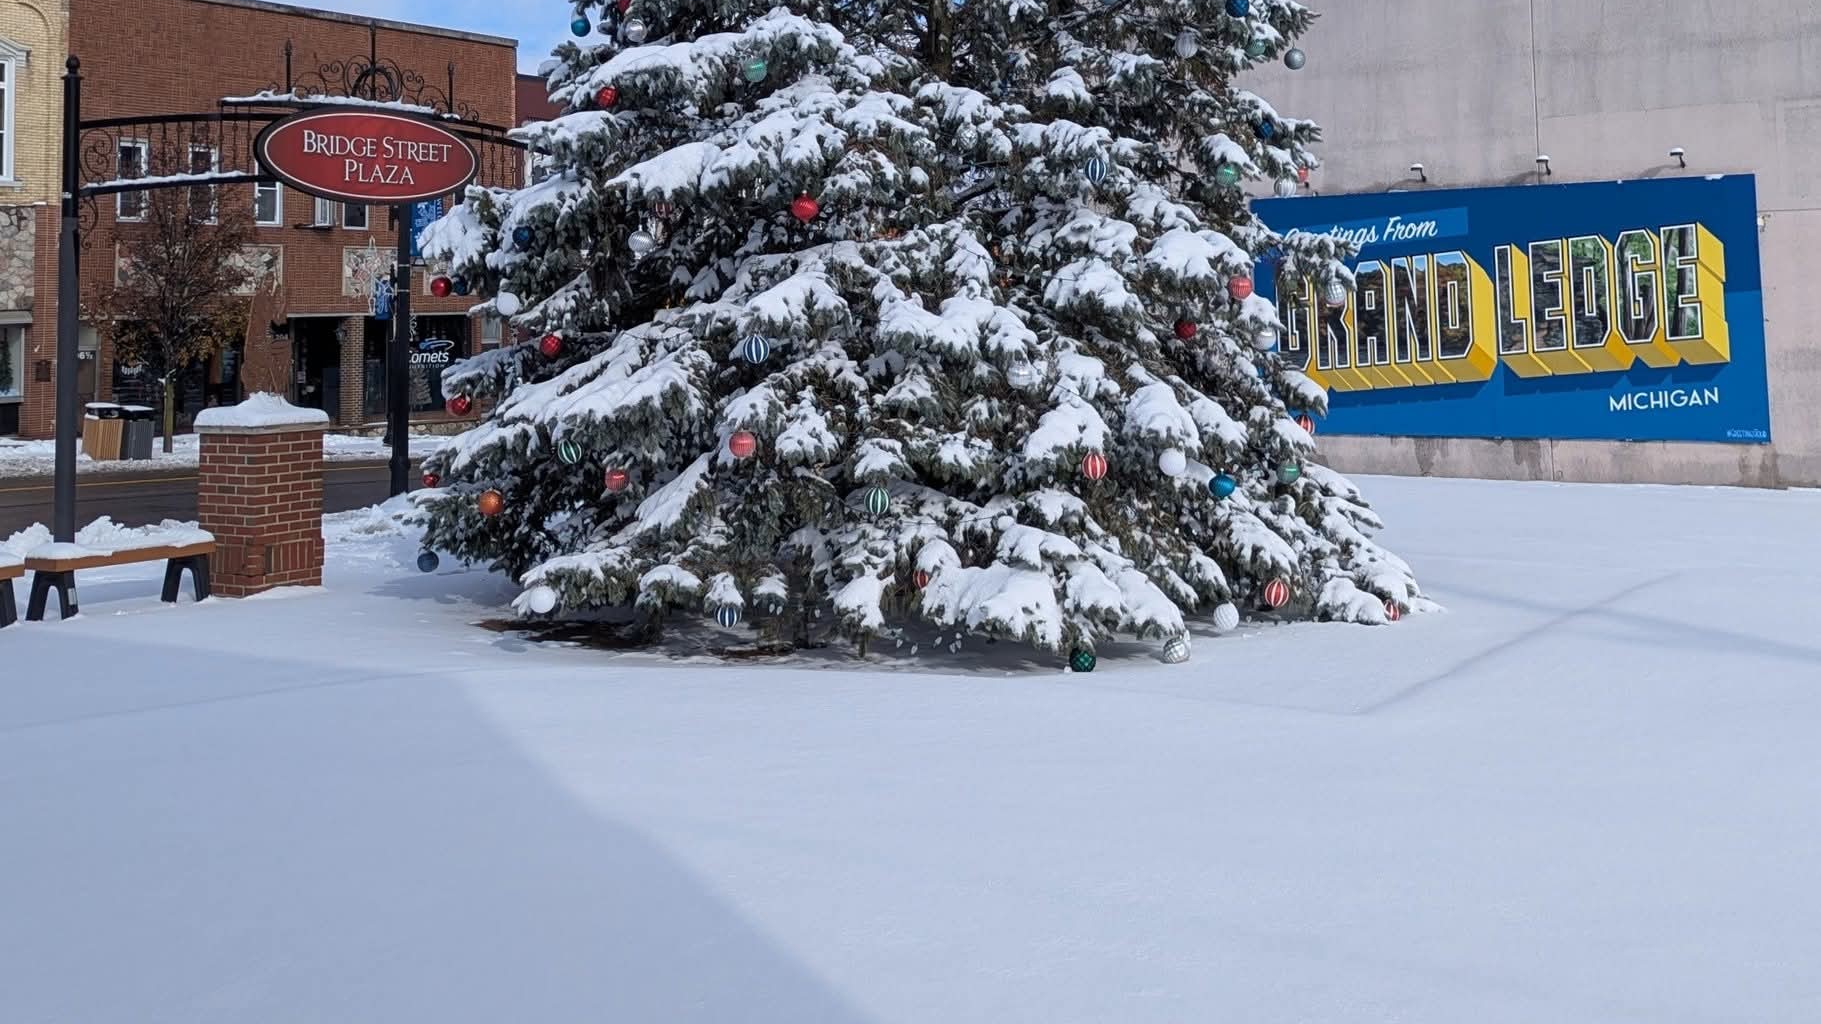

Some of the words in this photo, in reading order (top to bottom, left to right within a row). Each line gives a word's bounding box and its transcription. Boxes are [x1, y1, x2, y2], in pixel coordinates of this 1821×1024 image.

[302, 129, 377, 159] BRIDGE
[382, 136, 452, 164] STREET
[343, 158, 415, 185] PLAZA
[1284, 224, 1379, 251] tings
[1382, 215, 1438, 241] From
[1493, 222, 1730, 378] LEDGE
[409, 350, 449, 364] omets
[1609, 386, 1719, 412] MICHIGAN
